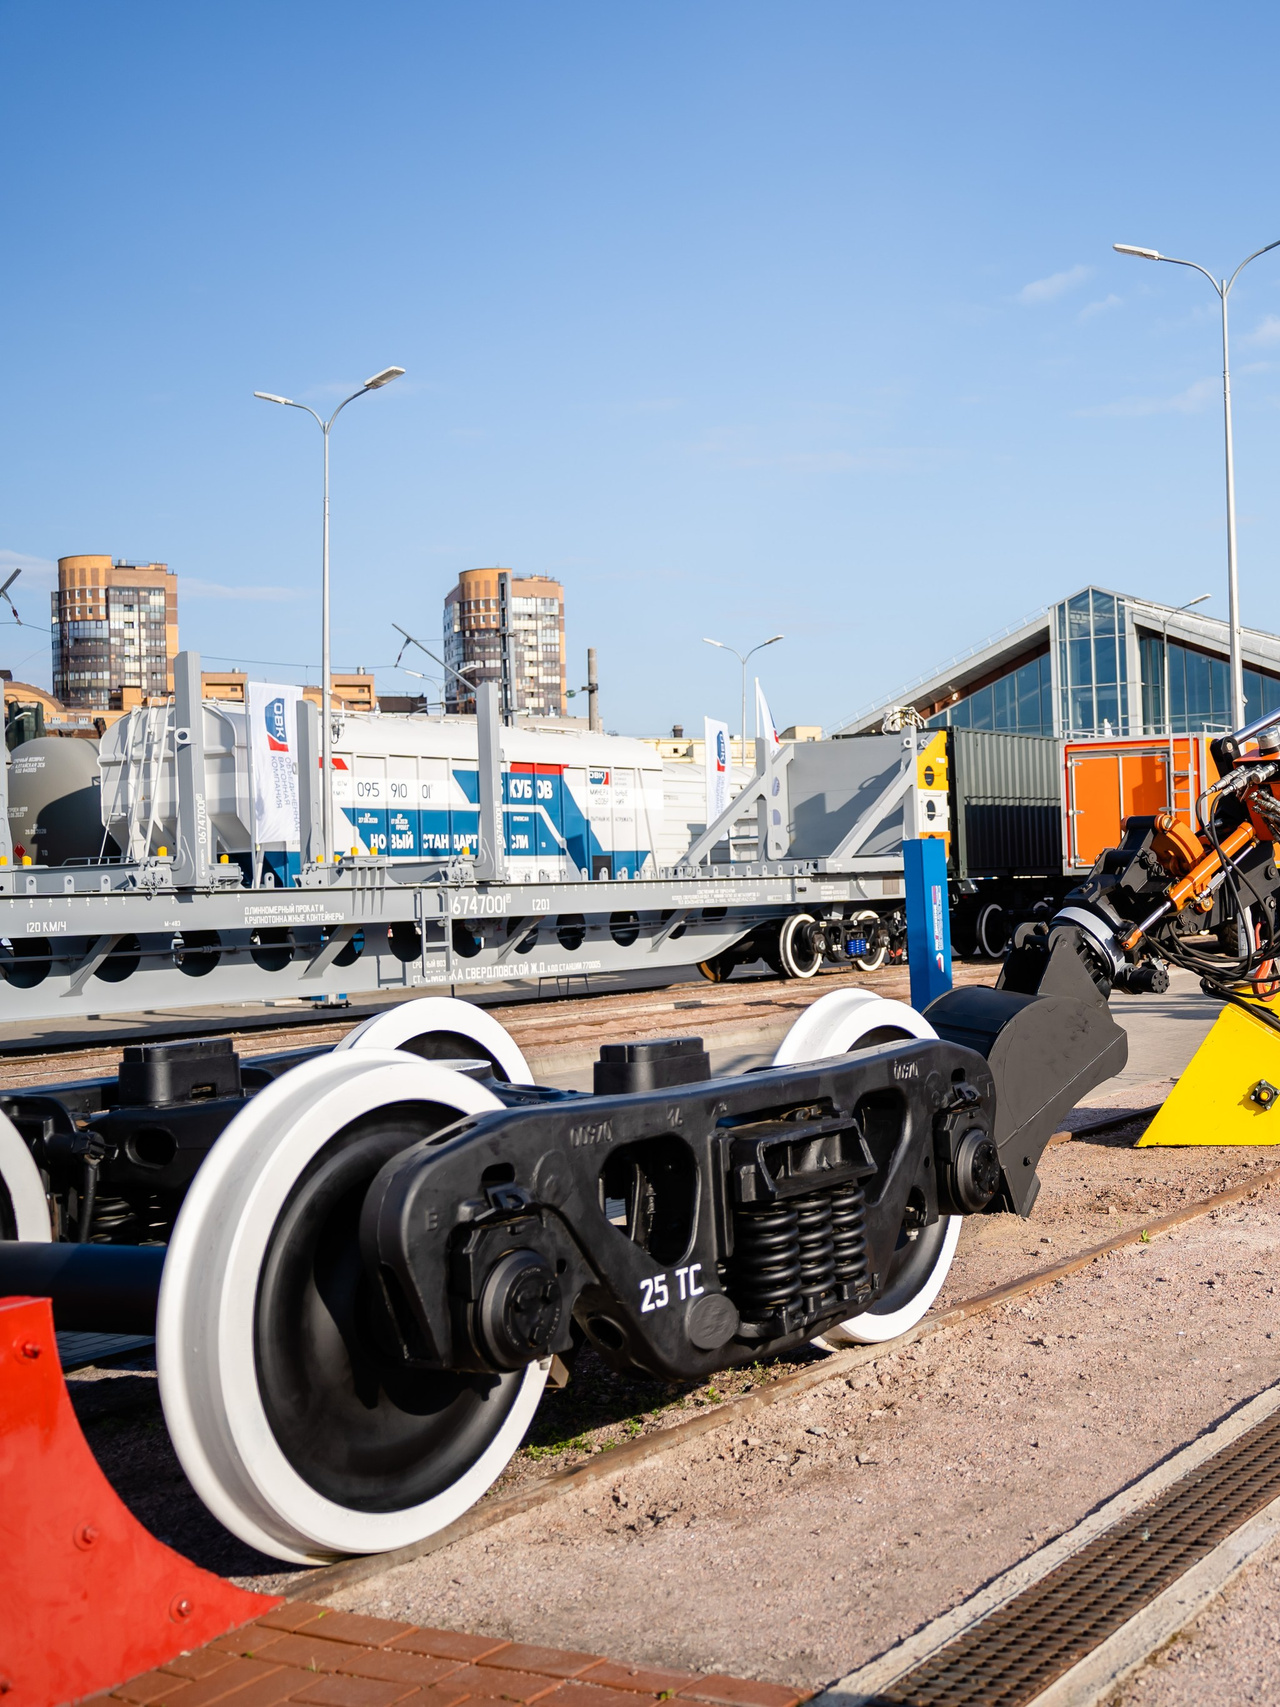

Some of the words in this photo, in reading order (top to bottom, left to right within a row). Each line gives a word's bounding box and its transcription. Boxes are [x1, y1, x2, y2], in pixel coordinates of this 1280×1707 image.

[273, 701, 286, 739] ОВК
[271, 755, 283, 809] КОМПАНИЯ
[277, 756, 291, 807] ВАГОННАЯ
[357, 782, 380, 798] 095
[391, 783, 408, 798] 910
[295, 904, 319, 913] ПРОКАТ
[450, 895, 506, 914] 6747001
[26, 922, 41, 933] 120
[42, 921, 67, 932] КМ/Ч
[244, 915, 306, 925] КРУПНОТОННАЖНЫЕ
[306, 911, 345, 922] КОНТЕЙНЕРЫ
[465, 962, 529, 981] СВЕРДЛОВСКОЙ
[639, 1273, 669, 1313] 25
[675, 1263, 704, 1300] ТС
